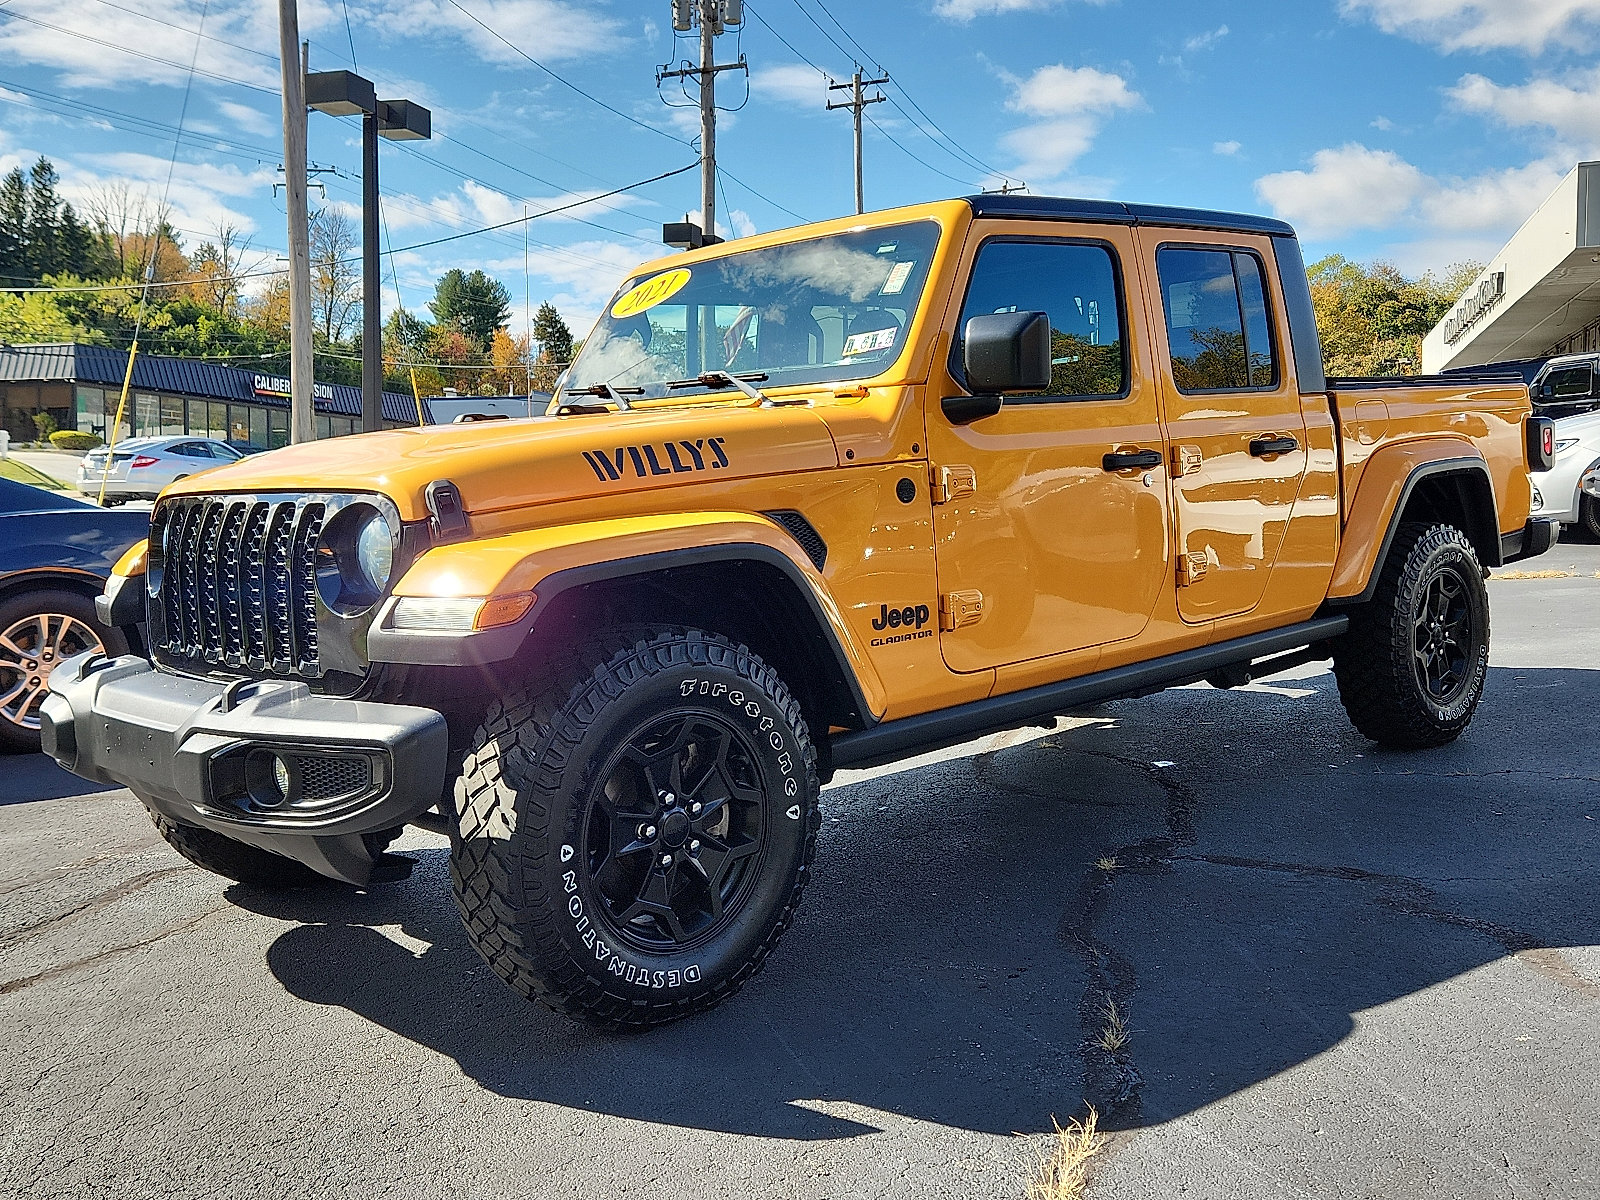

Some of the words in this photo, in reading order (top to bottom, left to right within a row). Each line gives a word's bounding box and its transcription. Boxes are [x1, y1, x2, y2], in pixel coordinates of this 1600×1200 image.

[621, 273, 679, 313] 2021
[254, 375, 291, 393] CALIBER
[581, 437, 729, 481] WILLYS
[871, 604, 930, 631] Jeep
[870, 630, 933, 647] GLADIATOR
[680, 678, 797, 797] Firestone
[562, 870, 701, 989] DESTINATION
